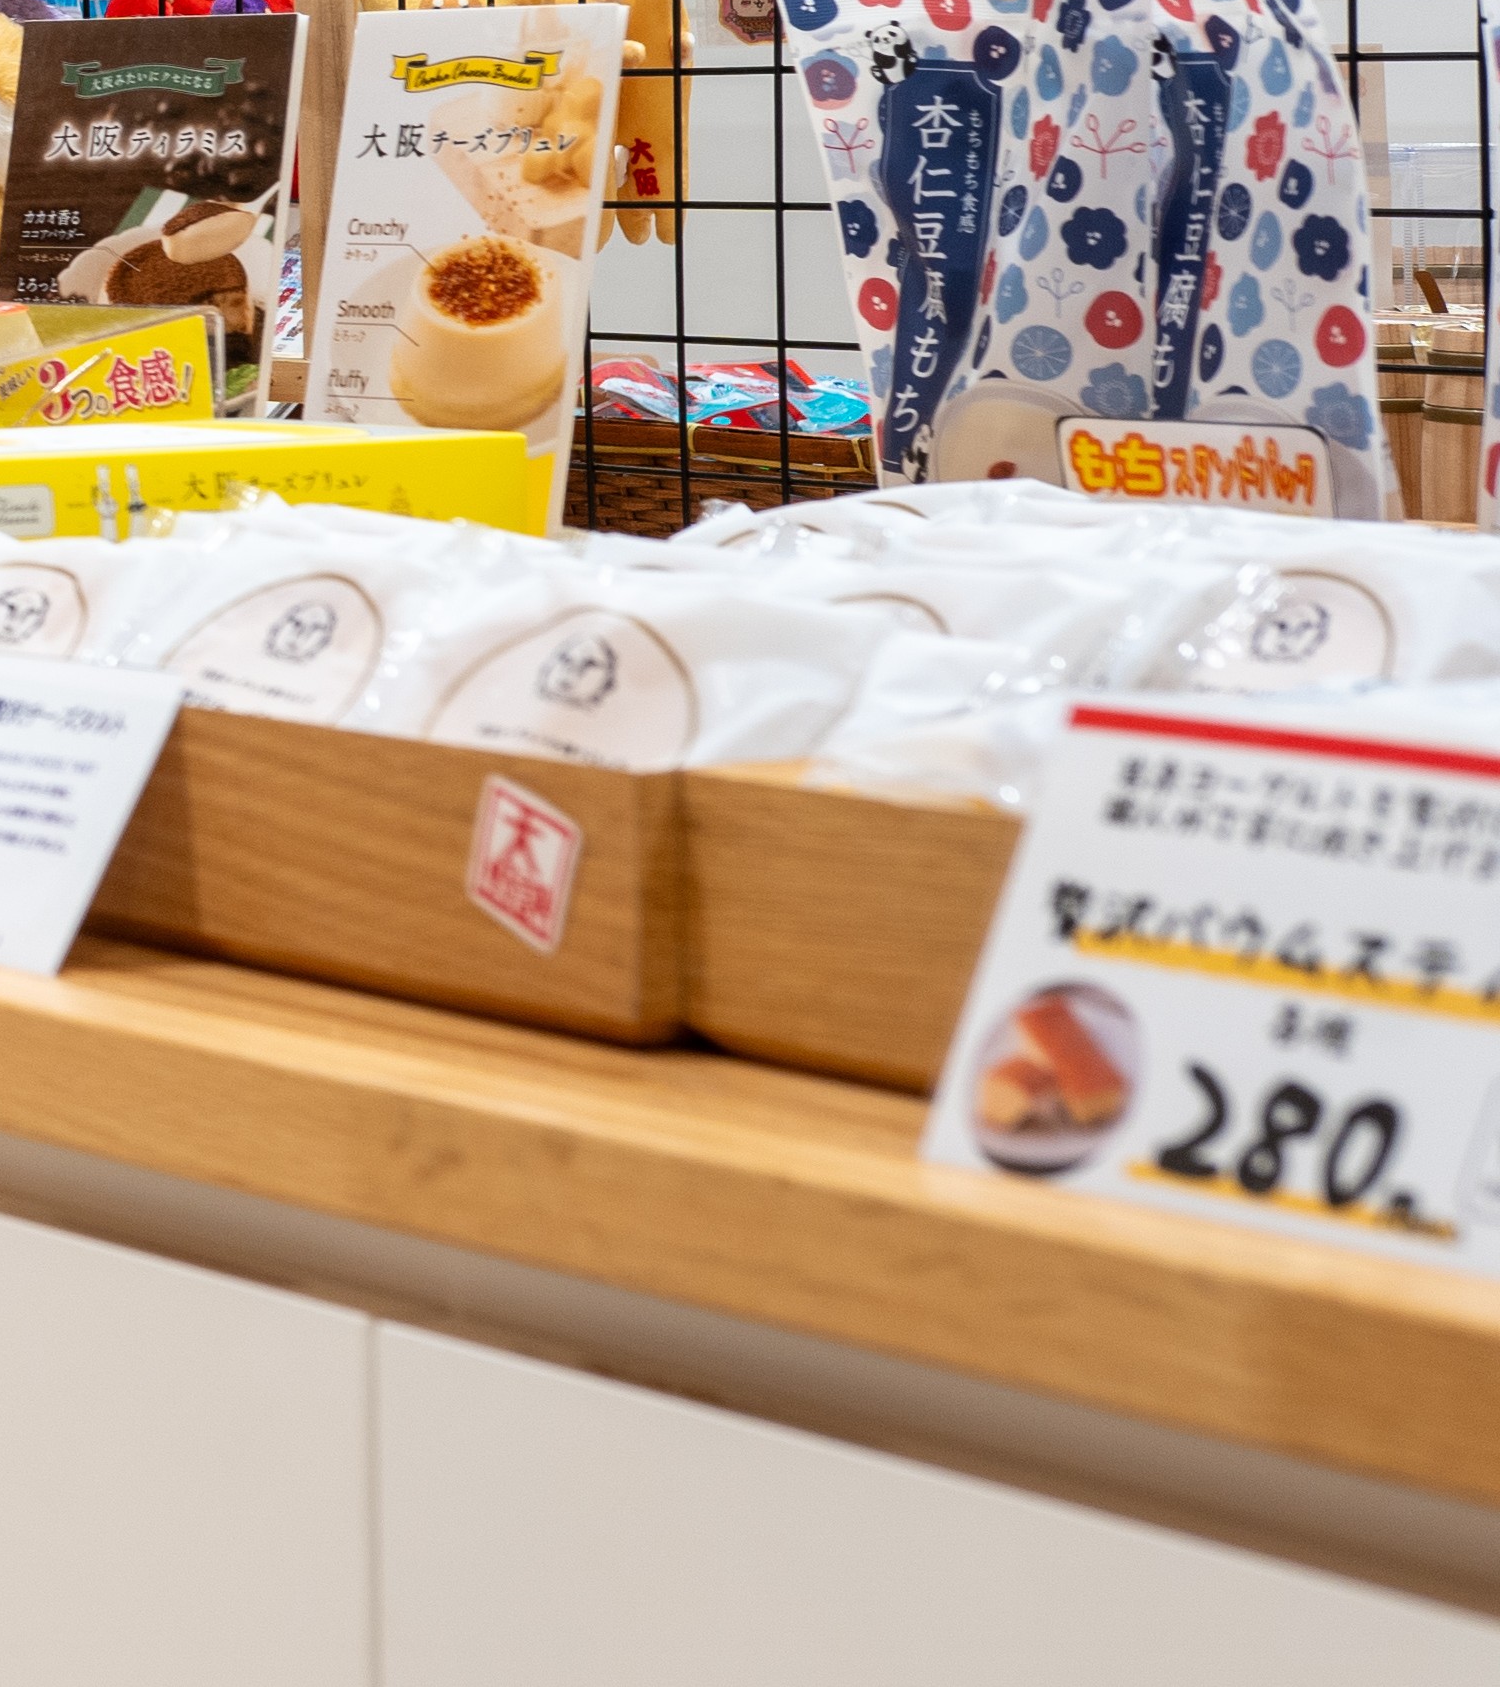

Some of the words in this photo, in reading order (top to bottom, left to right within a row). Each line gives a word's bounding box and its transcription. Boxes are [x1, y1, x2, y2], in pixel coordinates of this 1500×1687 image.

[45, 123, 246, 161] 大阪ティラミス
[357, 123, 576, 160] 大阪チーズブリュレ
[629, 137, 660, 196] 大阪
[348, 217, 409, 240] Crunchy
[17, 277, 58, 292] とろっと
[337, 300, 396, 319] Smooth
[1153, 1057, 1404, 1209] 280
